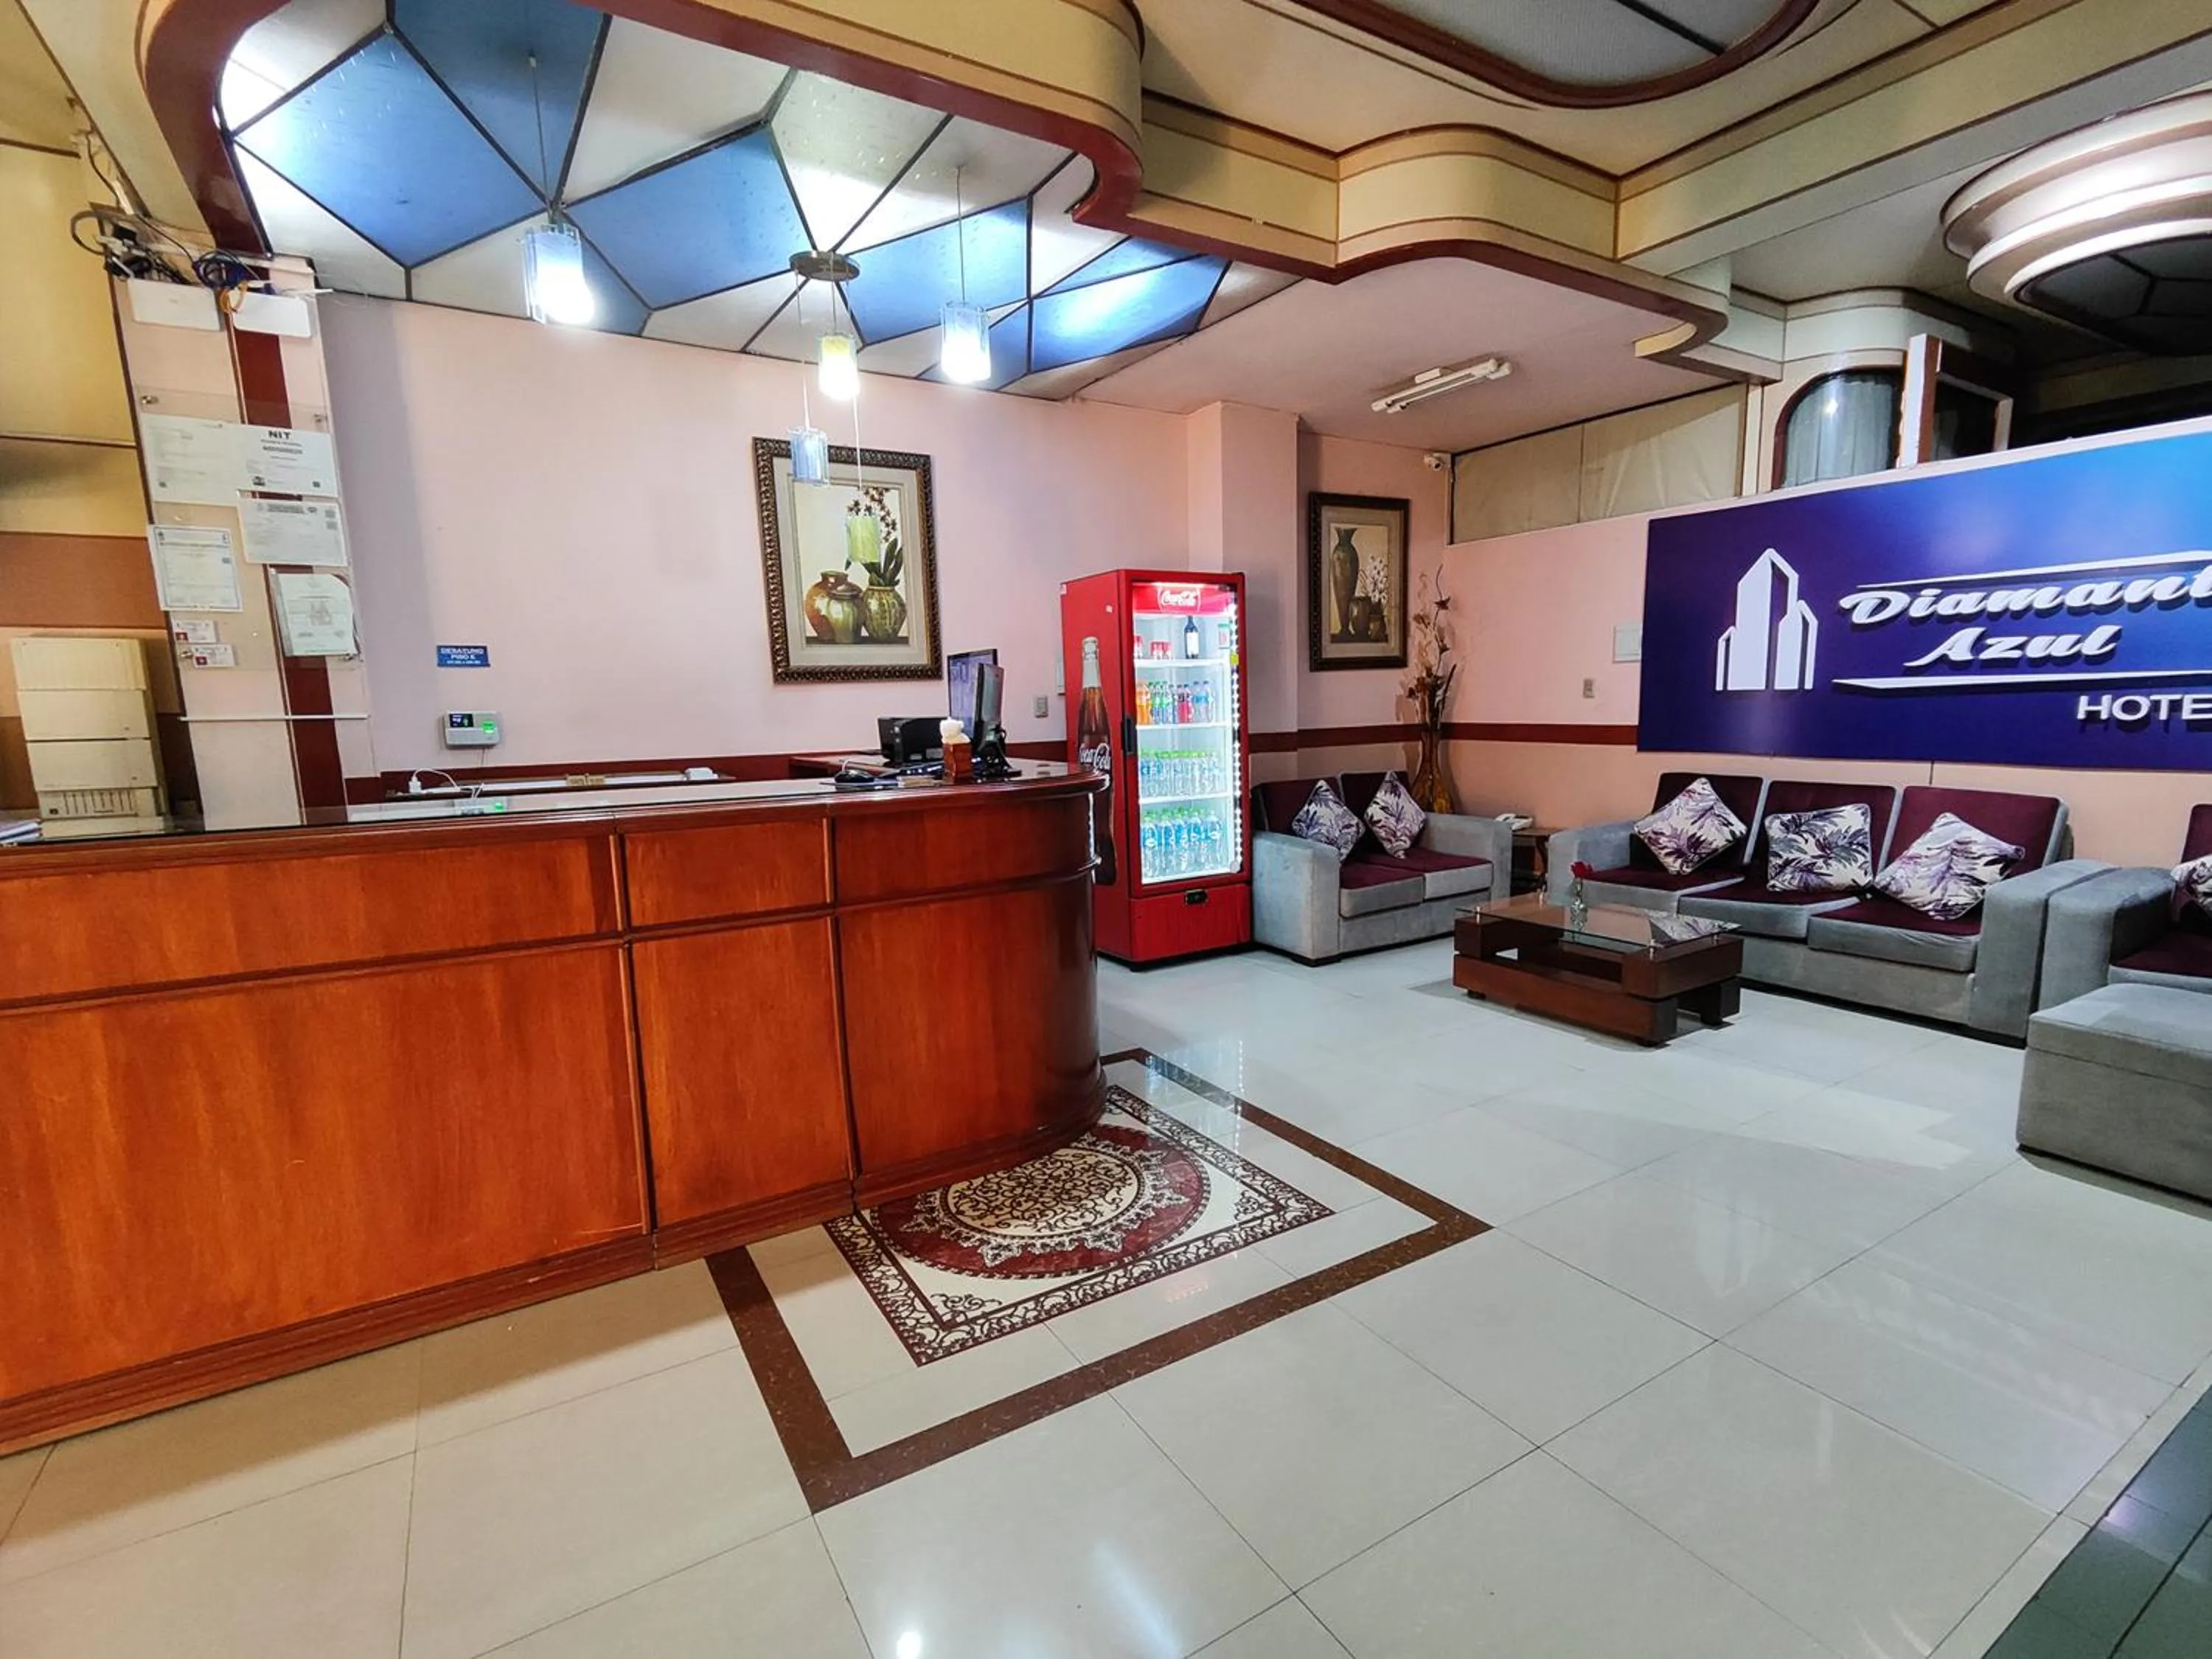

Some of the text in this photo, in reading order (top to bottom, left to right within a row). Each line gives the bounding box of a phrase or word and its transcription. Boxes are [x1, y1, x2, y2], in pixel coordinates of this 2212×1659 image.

[268, 430, 291, 440] NIT
[1903, 625, 2123, 666] Azul
[2076, 694, 2212, 721] HOTE
